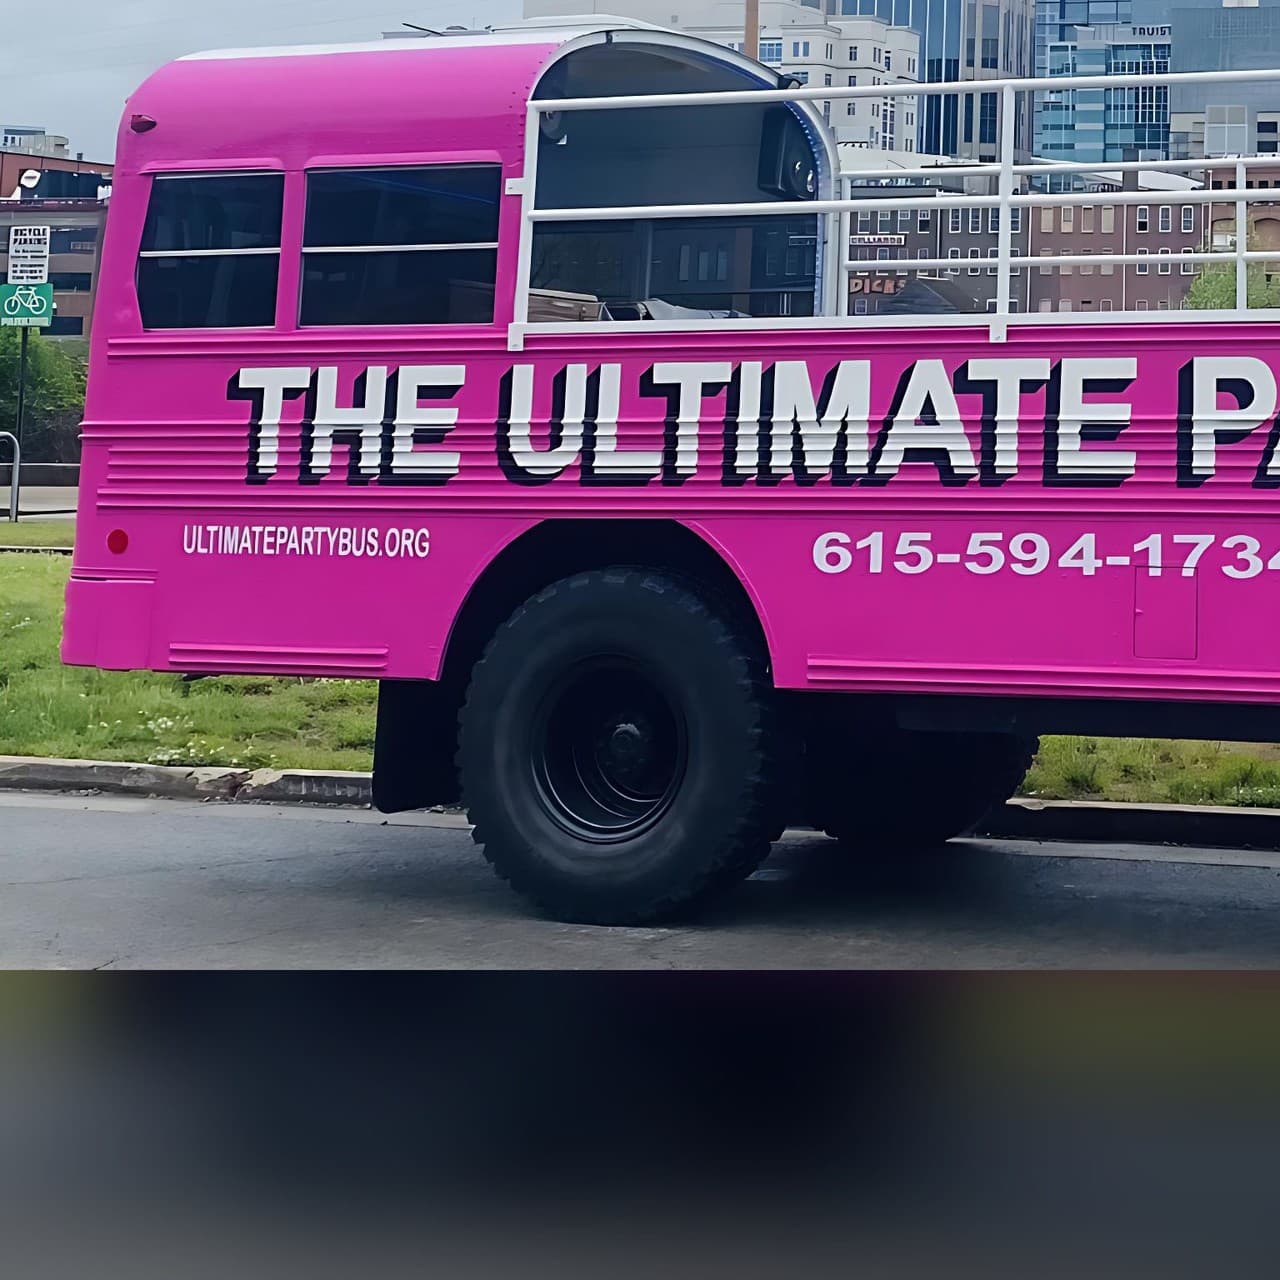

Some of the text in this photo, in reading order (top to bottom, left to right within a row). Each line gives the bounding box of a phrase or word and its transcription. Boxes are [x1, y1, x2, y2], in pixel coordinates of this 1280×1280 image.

[230, 364, 466, 484] THE
[499, 357, 1138, 486] ULTIMATE
[183, 524, 430, 558] ULTIMATEPARTYBUS.ORG
